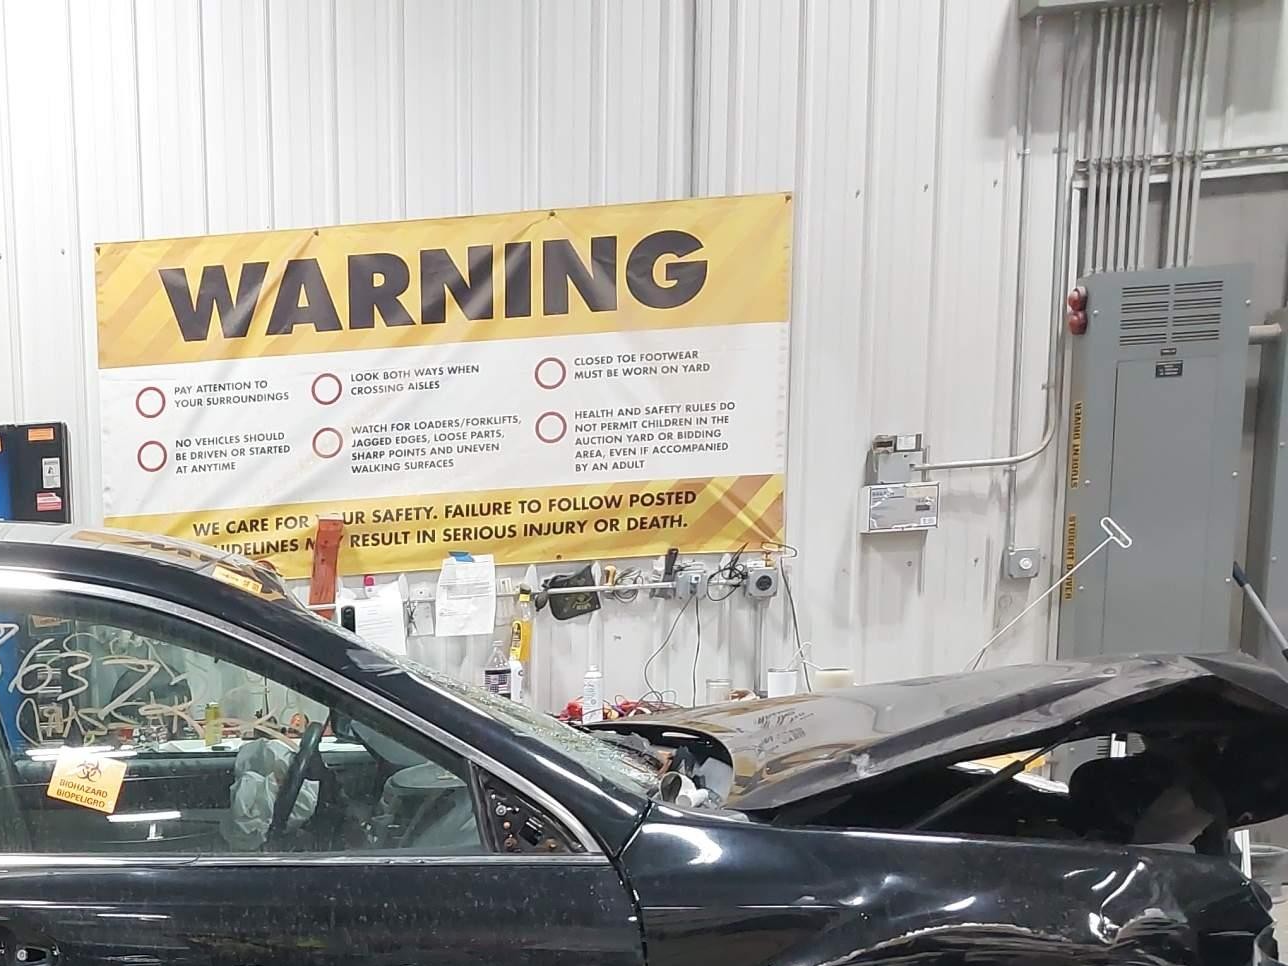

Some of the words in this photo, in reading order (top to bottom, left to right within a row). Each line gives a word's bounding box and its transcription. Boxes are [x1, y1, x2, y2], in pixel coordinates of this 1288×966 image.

[159, 230, 708, 342] WARNING
[574, 356, 613, 367] CLOSED
[617, 354, 637, 364] TOE
[640, 350, 698, 362] FOOTWEAR
[351, 370, 379, 382] LOOK
[383, 369, 411, 380] BOTH
[414, 367, 444, 378] WAYS
[447, 365, 479, 376] WHEN
[574, 369, 603, 380] MUST
[607, 368, 619, 378] BE
[622, 365, 657, 377] WORN
[661, 364, 679, 375] ON
[682, 363, 710, 373] YARD
[174, 385, 192, 395] PAY
[196, 381, 251, 393] ATTENTION
[255, 380, 268, 389] TO
[351, 384, 404, 396] CROSSING
[408, 381, 440, 391] AISLES
[175, 397, 203, 408] YOUR
[207, 392, 289, 406] SURROUNDINGS
[575, 408, 613, 420] HEALTH
[617, 407, 641, 417] AND
[645, 404, 683, 415] SAFETY
[686, 403, 717, 413] RULES
[720, 401, 736, 411] DO
[352, 423, 387, 434] WATCH
[391, 421, 411, 432] FOR
[414, 415, 522, 430] LOADERS/FORKLIFTS,
[575, 422, 598, 433] NOT
[601, 420, 638, 431] PERMIT
[641, 417, 692, 429] CHILDREN
[696, 416, 708, 426] IN
[711, 415, 729, 425] THE
[1073, 402, 1083, 440] DRIVER
[176, 439, 191, 448] NO
[194, 435, 241, 446] VEHICLES
[244, 432, 285, 443] SHOULD
[352, 435, 392, 447] JAGGED
[396, 434, 431, 446] EDGES,
[434, 431, 467, 443] LOOSE
[471, 429, 505, 440] PARTS,
[575, 434, 622, 447] AUCTION
[625, 432, 654, 443] YARD
[657, 431, 674, 441] OR
[677, 429, 721, 440] BIDDING
[176, 452, 187, 461] BE
[190, 449, 227, 460] DRIVEN
[231, 447, 245, 457] OR
[248, 445, 290, 456] STARTED
[352, 449, 385, 461] SHARP
[389, 447, 427, 458] POINTS
[430, 445, 453, 456] AND
[456, 442, 500, 455] UNEVEN
[575, 448, 606, 459] AREA,
[609, 446, 637, 457] EVEN
[640, 445, 649, 455] IF
[652, 441, 729, 455] ACCOMPANIED
[176, 464, 188, 474] AT
[190, 461, 236, 472] ANYTIME
[352, 462, 400, 474] WALKING
[404, 459, 454, 471] SURFACES
[575, 462, 589, 472] BY
[592, 461, 609, 471] AN
[612, 459, 645, 470] ADULT
[1070, 441, 1081, 488] STUDENT
[193, 522, 220, 537] WE
[226, 518, 271, 534] CARE
[275, 515, 309, 530] FOR
[316, 511, 365, 525] UR
[372, 506, 438, 523] SAFETY.
[444, 501, 512, 519] FAILURE
[518, 499, 541, 513] TO
[548, 493, 623, 512] FOLLOW
[629, 490, 696, 507] POSTED
[214, 539, 299, 556] UIDELINES
[351, 531, 409, 547] RESULT
[416, 529, 436, 543] IN
[443, 523, 517, 543] SERIOUS
[524, 518, 588, 537] INJURY
[594, 518, 619, 533] OR
[627, 515, 687, 531] DEATH.
[1066, 515, 1077, 562] STUDENT
[1065, 564, 1074, 600] DIVER
[59, 779, 108, 798] BIOHAZARD
[56, 789, 105, 808] BIOPELIGRO
